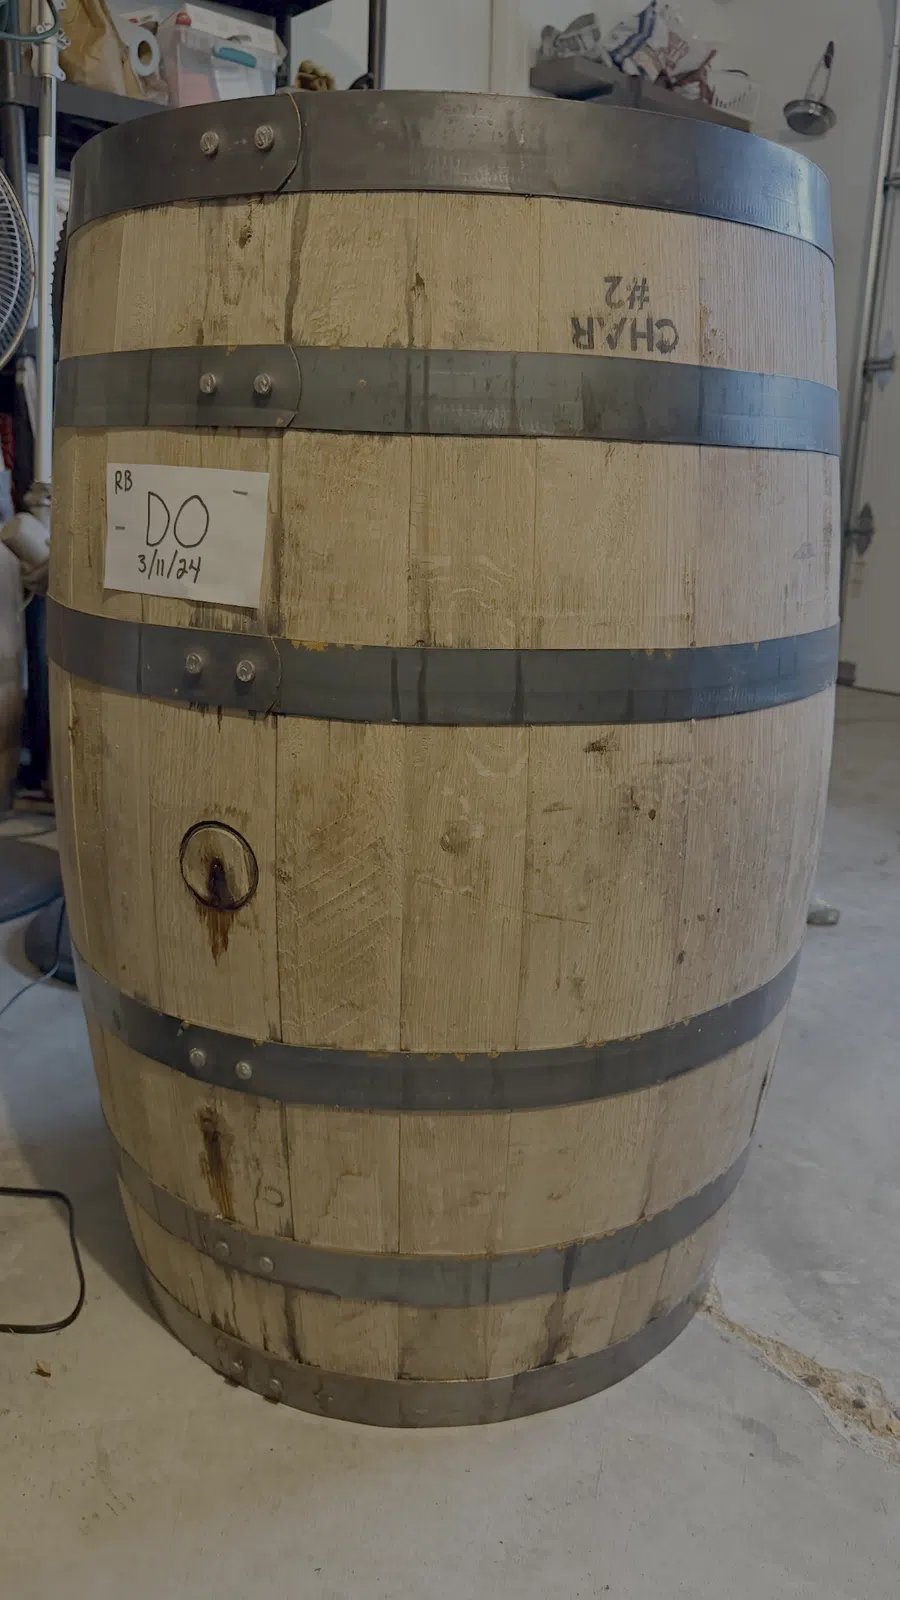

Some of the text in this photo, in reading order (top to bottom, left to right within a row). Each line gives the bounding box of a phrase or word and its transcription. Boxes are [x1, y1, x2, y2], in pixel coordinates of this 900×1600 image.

[603, 275, 649, 310] #2
[571, 316, 679, 354] CHAR
[114, 469, 133, 494] RB
[146, 491, 209, 548] DO
[138, 549, 201, 583] 3/11/24
